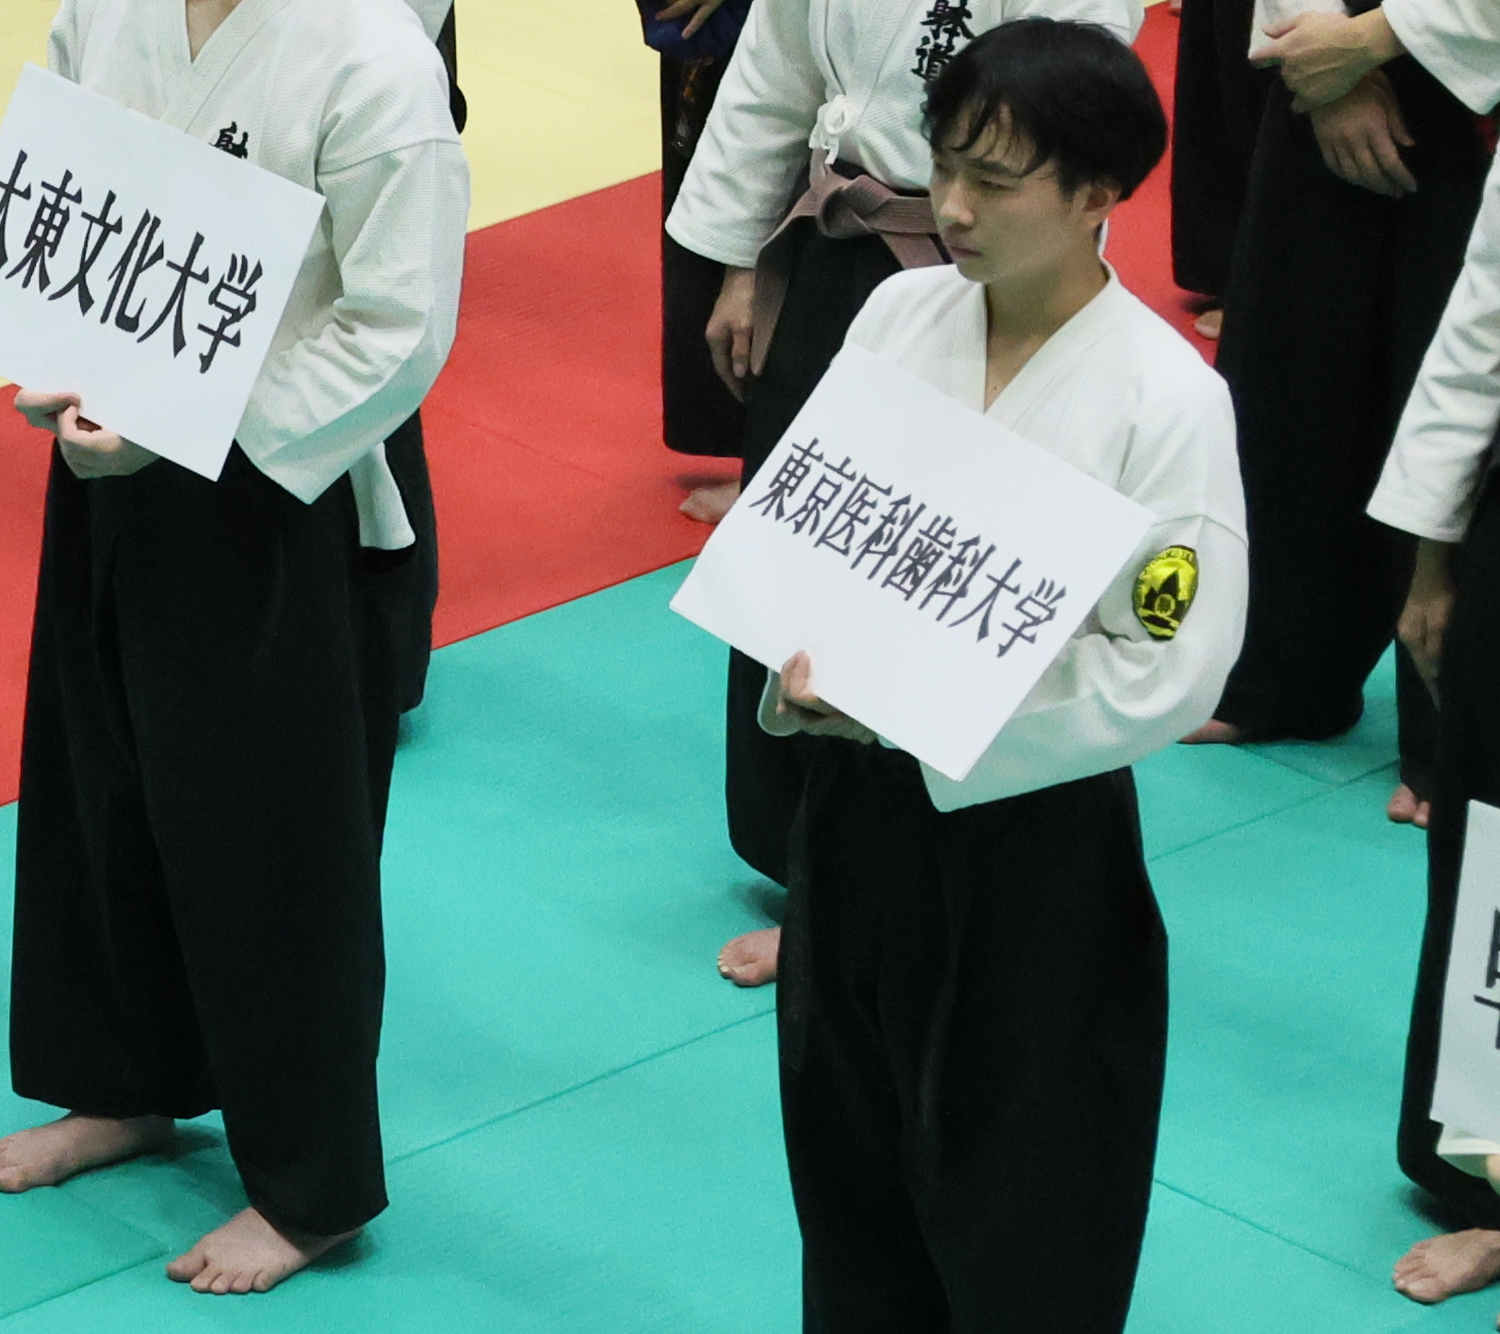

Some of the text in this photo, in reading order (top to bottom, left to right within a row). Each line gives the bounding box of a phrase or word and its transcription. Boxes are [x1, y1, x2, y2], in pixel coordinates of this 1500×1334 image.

[750, 437, 1067, 659] 東京医科歯科大学
